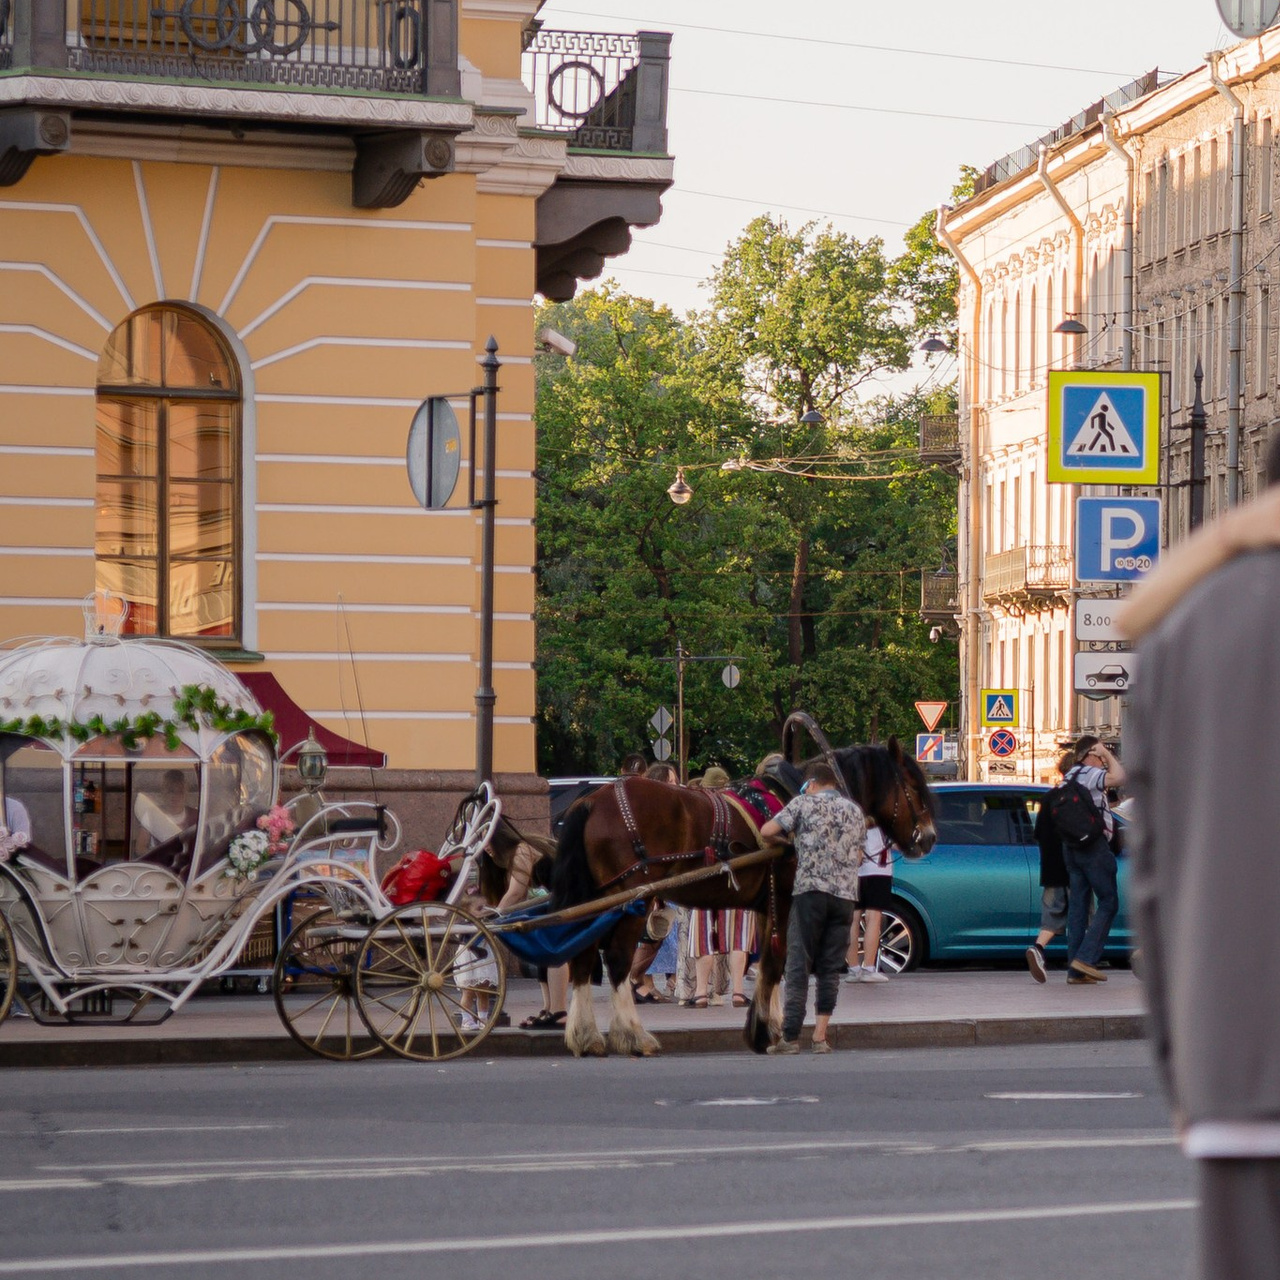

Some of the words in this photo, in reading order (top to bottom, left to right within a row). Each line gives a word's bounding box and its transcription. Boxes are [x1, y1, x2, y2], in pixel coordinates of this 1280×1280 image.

[1101, 507, 1145, 572] P
[1126, 559, 1135, 568] 15
[1137, 558, 1150, 569] 20
